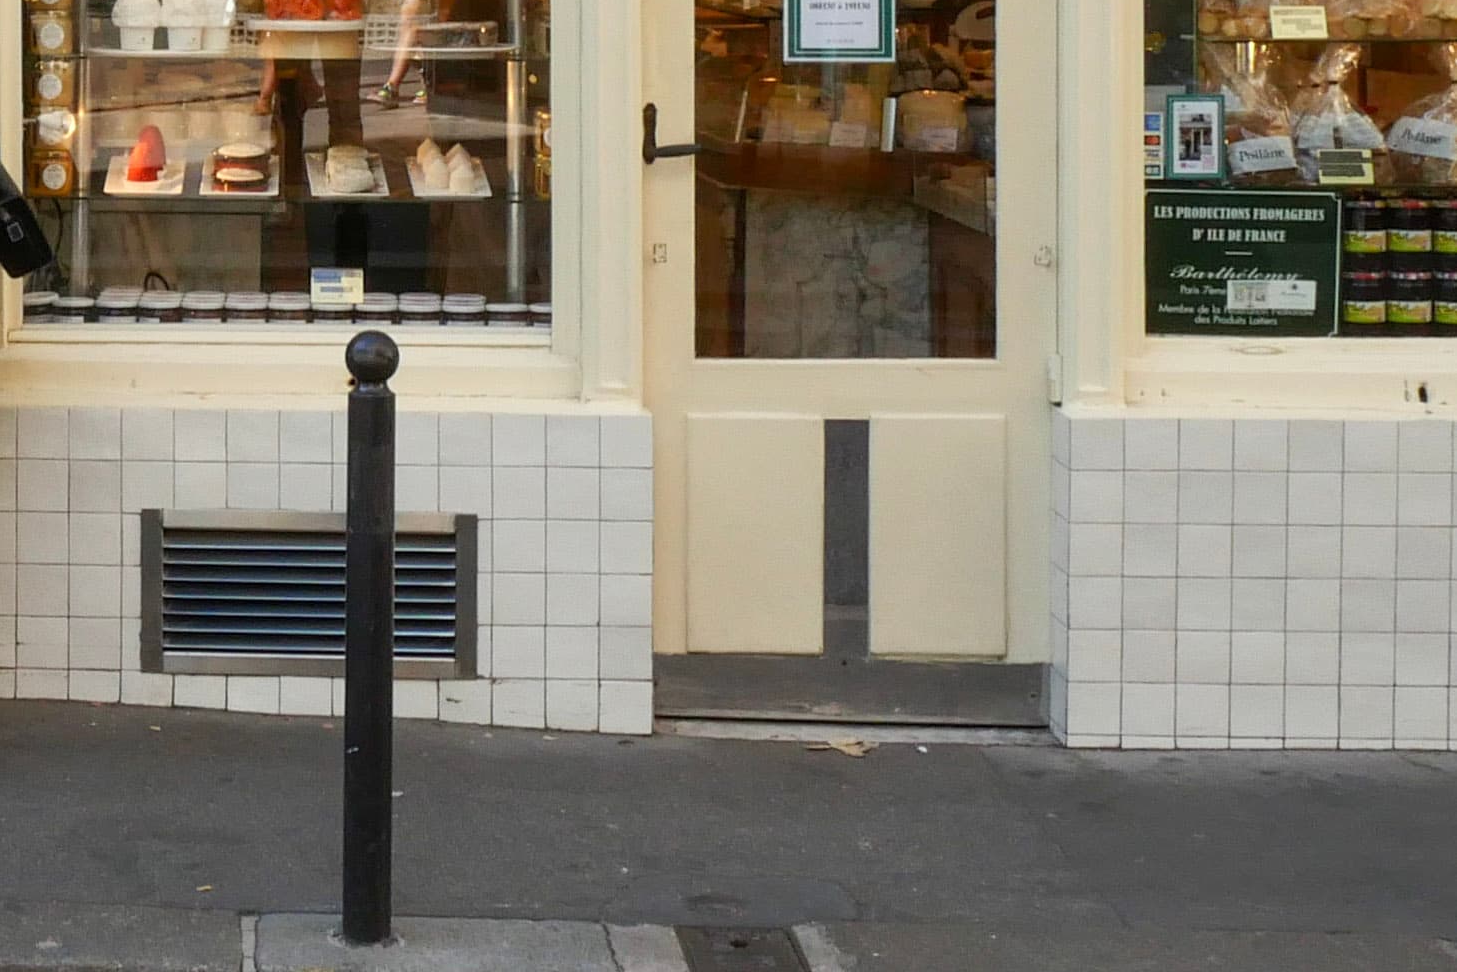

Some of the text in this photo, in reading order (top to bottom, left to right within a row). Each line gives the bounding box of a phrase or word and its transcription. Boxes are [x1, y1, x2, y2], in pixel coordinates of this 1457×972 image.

[1153, 205, 1325, 222] LES PRODUCTIONS FROMAGERES
[1207, 228, 1225, 242] ILE
[1228, 229, 1243, 242] DE
[1245, 229, 1287, 243] FRANCE
[1180, 284, 1201, 295] Paris
[1158, 304, 1195, 314] Membre
[1197, 304, 1210, 314] de
[1194, 315, 1209, 325] des
[1213, 315, 1247, 326] Produits
